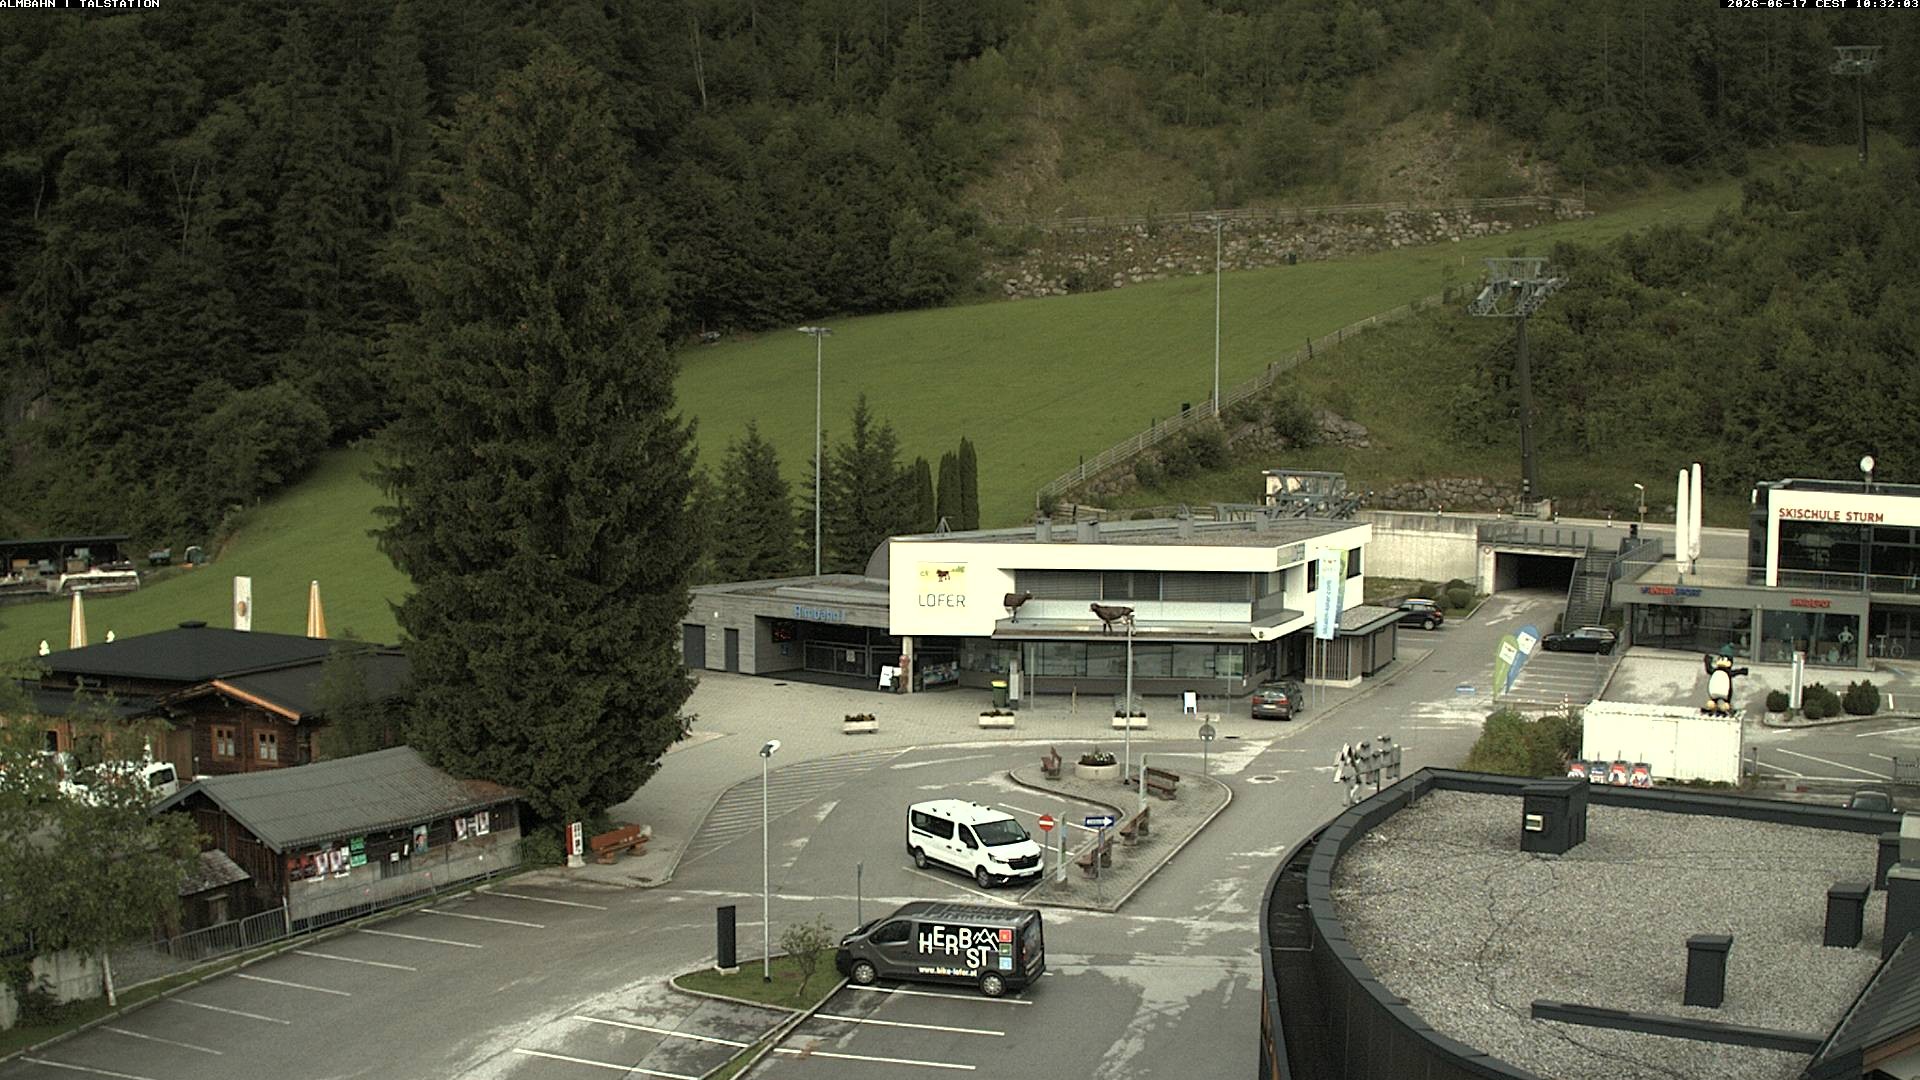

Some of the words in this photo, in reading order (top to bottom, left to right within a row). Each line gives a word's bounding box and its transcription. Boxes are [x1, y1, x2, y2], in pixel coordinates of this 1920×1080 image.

[1779, 508, 1840, 521] SKISCHULE
[1846, 512, 1883, 522] STURM
[918, 593, 966, 607] LOFER
[918, 967, 977, 977] www.bike-lofer.at
